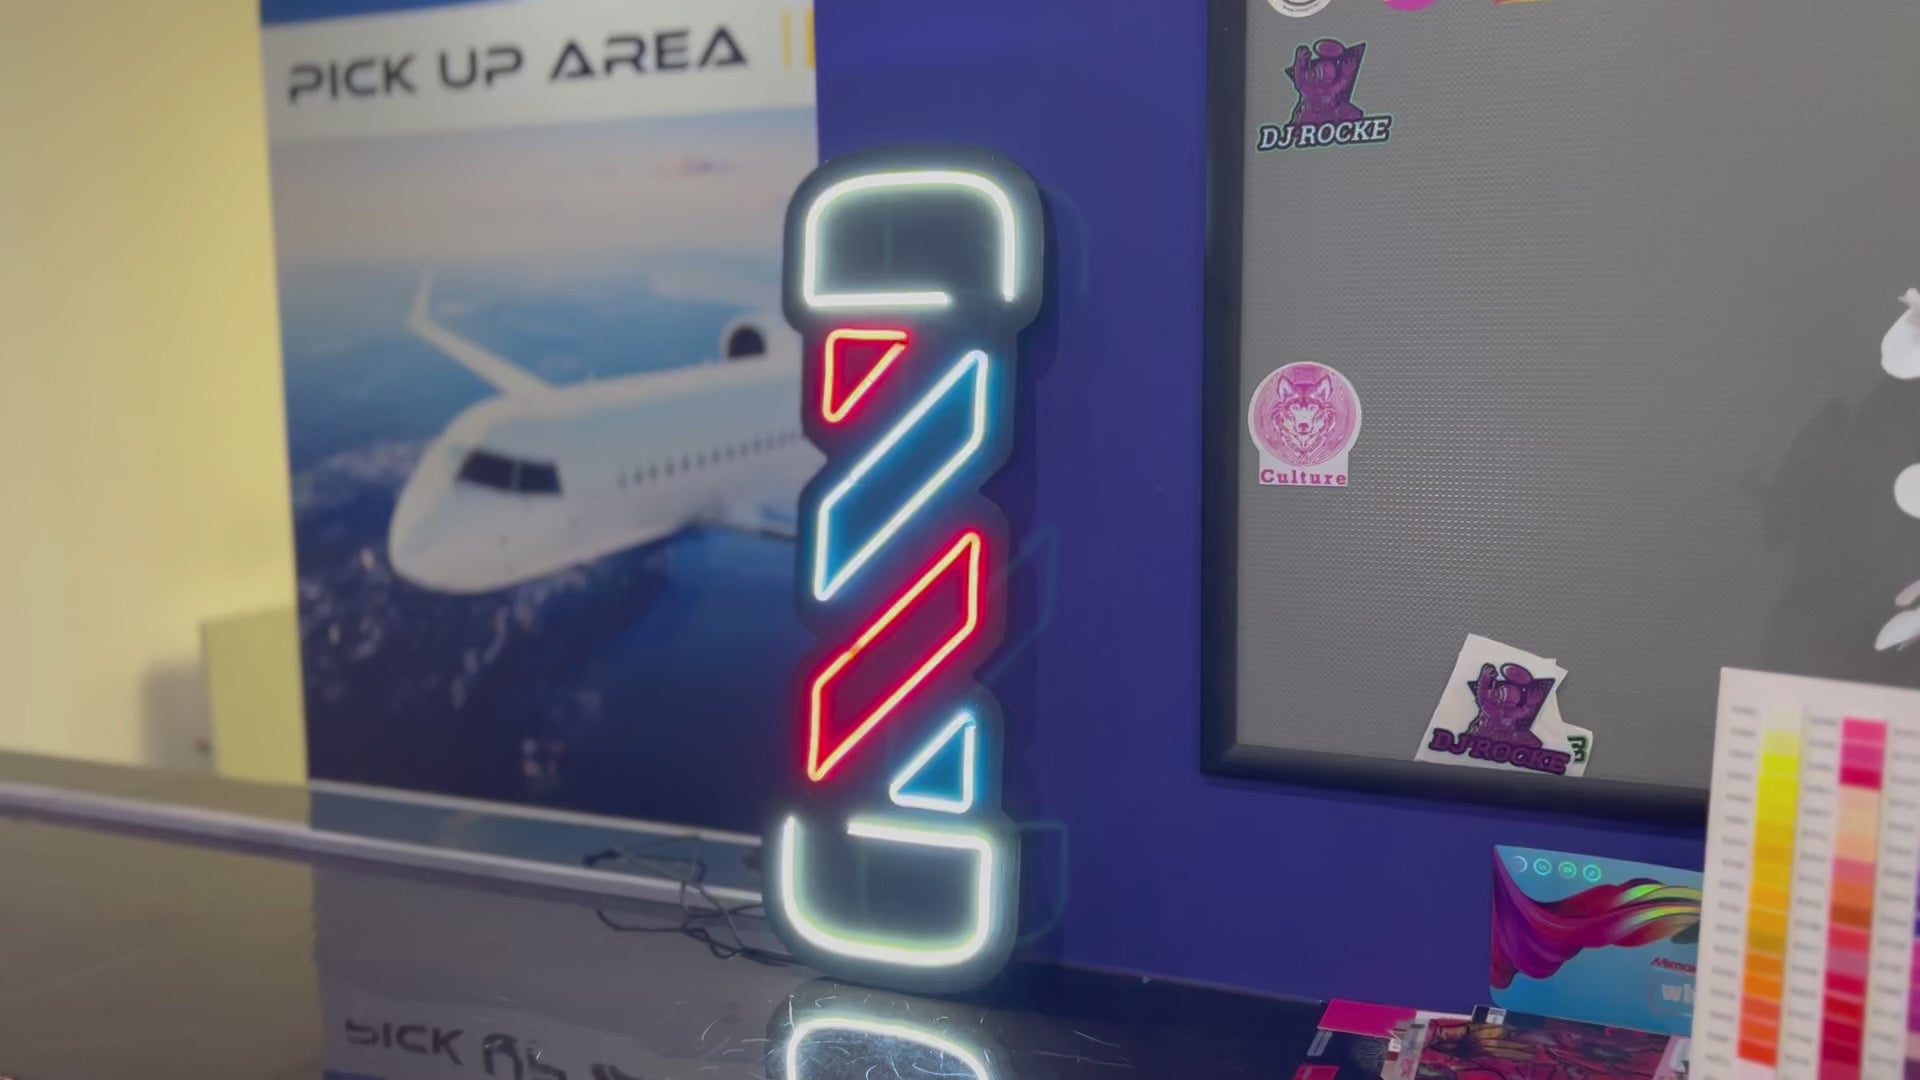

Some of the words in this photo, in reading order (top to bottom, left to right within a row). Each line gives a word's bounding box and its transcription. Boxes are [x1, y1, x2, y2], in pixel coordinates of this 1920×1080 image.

[288, 52, 417, 103] PICK
[437, 45, 525, 89] UP
[547, 26, 749, 83] AREA
[1260, 126, 1294, 149] DJ
[1299, 118, 1390, 145] ROCKE
[1260, 469, 1346, 485] Culture
[1430, 729, 1473, 754] DJ
